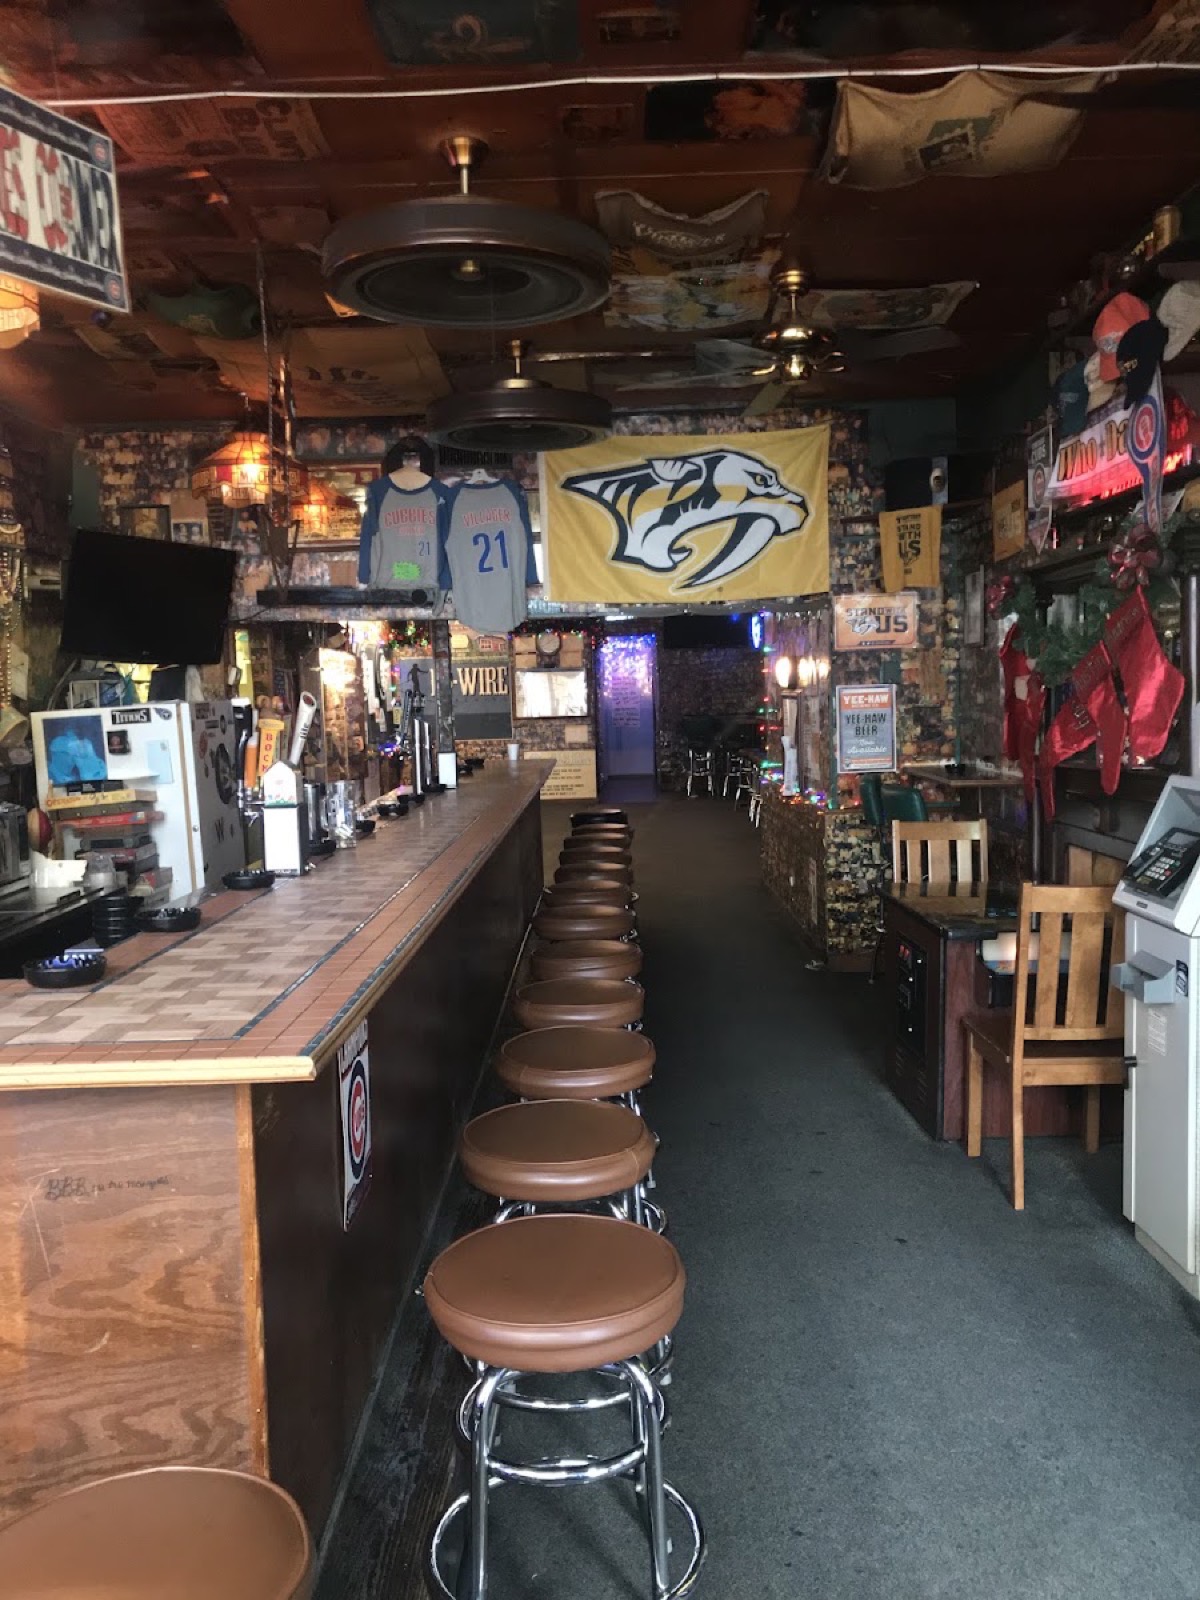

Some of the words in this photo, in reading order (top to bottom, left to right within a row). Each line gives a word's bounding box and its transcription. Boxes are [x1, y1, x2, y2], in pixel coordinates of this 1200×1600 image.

[417, 541, 430, 557] 21
[472, 529, 509, 574] 21
[874, 615, 908, 633] US
[843, 694, 889, 705] YEE-HAW
[846, 713, 887, 724] YEE-HAW
[855, 725, 878, 736] BEER
